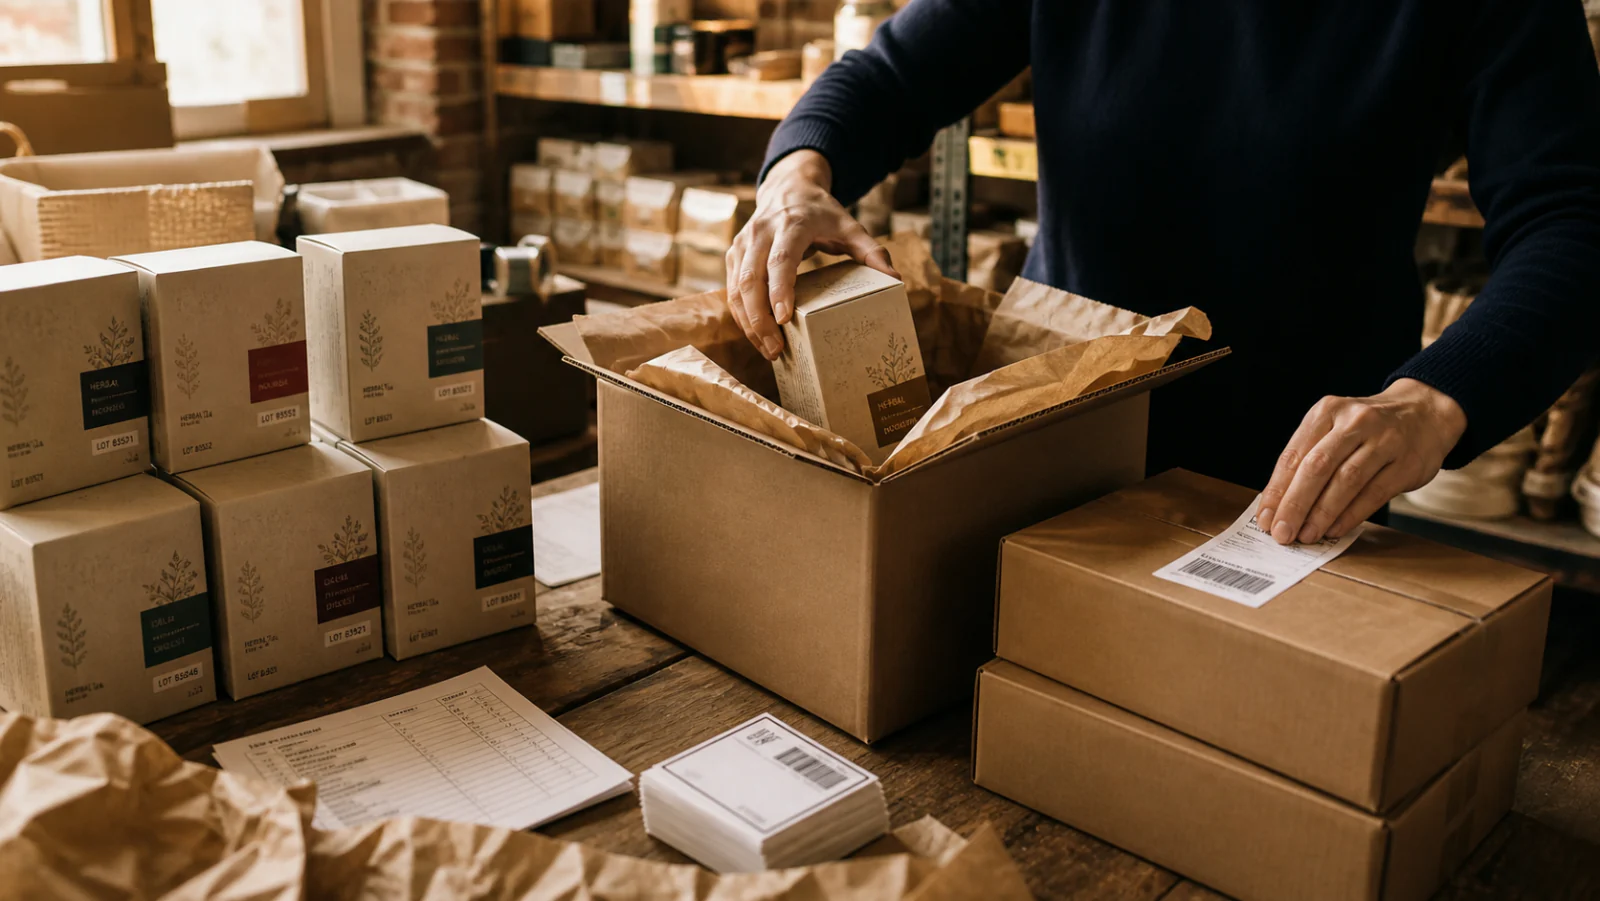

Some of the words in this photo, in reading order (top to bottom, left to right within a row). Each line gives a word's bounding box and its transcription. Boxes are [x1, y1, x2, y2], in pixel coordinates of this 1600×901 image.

[438, 388, 451, 397] LOT
[261, 413, 274, 424] LOT
[96, 440, 109, 451] LOT
[182, 446, 194, 455] LOT
[486, 597, 499, 607] LOT
[329, 632, 342, 643] LOT
[158, 676, 172, 688] LOT
